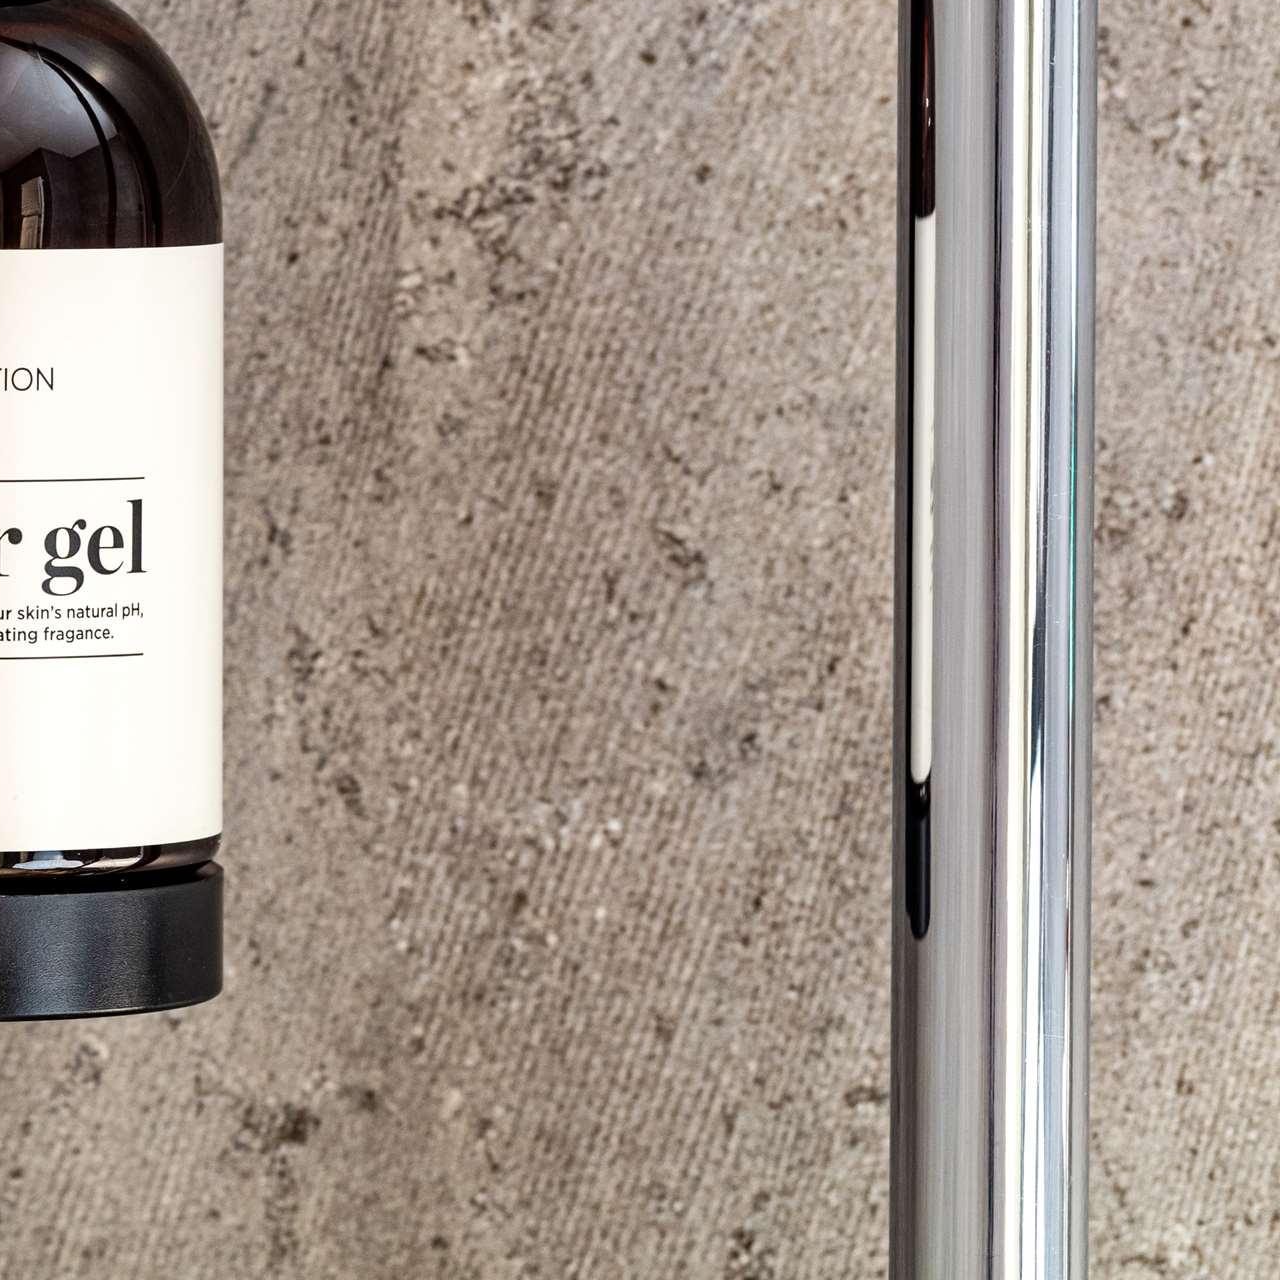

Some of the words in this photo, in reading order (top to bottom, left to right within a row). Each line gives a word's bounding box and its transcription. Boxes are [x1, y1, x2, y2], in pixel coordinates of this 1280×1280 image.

[41, 498, 147, 596] gel
[17, 605, 61, 620] skin's
[66, 602, 117, 618] natural
[122, 602, 143, 619] pH,
[43, 626, 114, 643] fragance.
